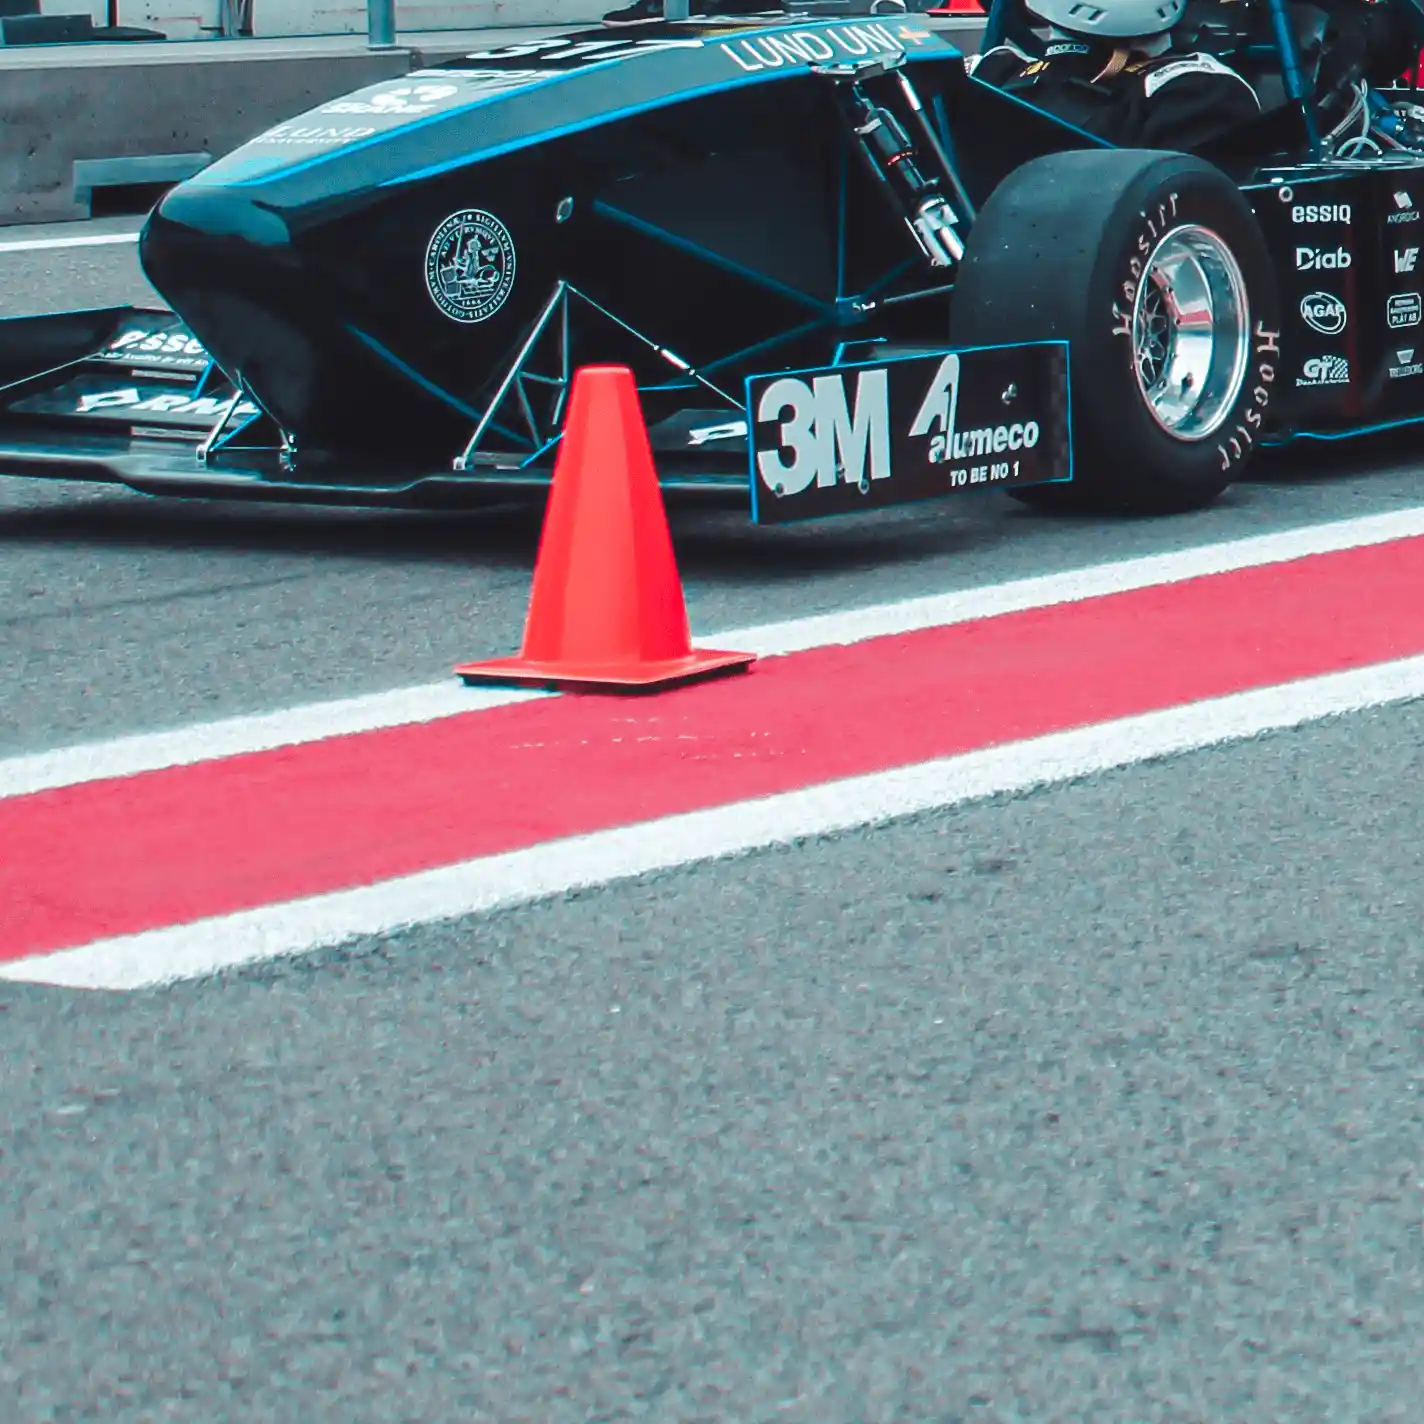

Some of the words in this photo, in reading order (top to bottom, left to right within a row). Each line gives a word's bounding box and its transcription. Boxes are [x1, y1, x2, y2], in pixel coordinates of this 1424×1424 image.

[721, 32, 834, 71] LUND
[827, 23, 905, 55] UNI
[1296, 246, 1351, 271] Diab
[757, 368, 891, 497] 3M
[928, 421, 1040, 464] alumeco
[950, 470, 967, 487] TO
[970, 466, 987, 483] BE
[990, 463, 1009, 481] NO
[1013, 461, 1020, 477] 1
